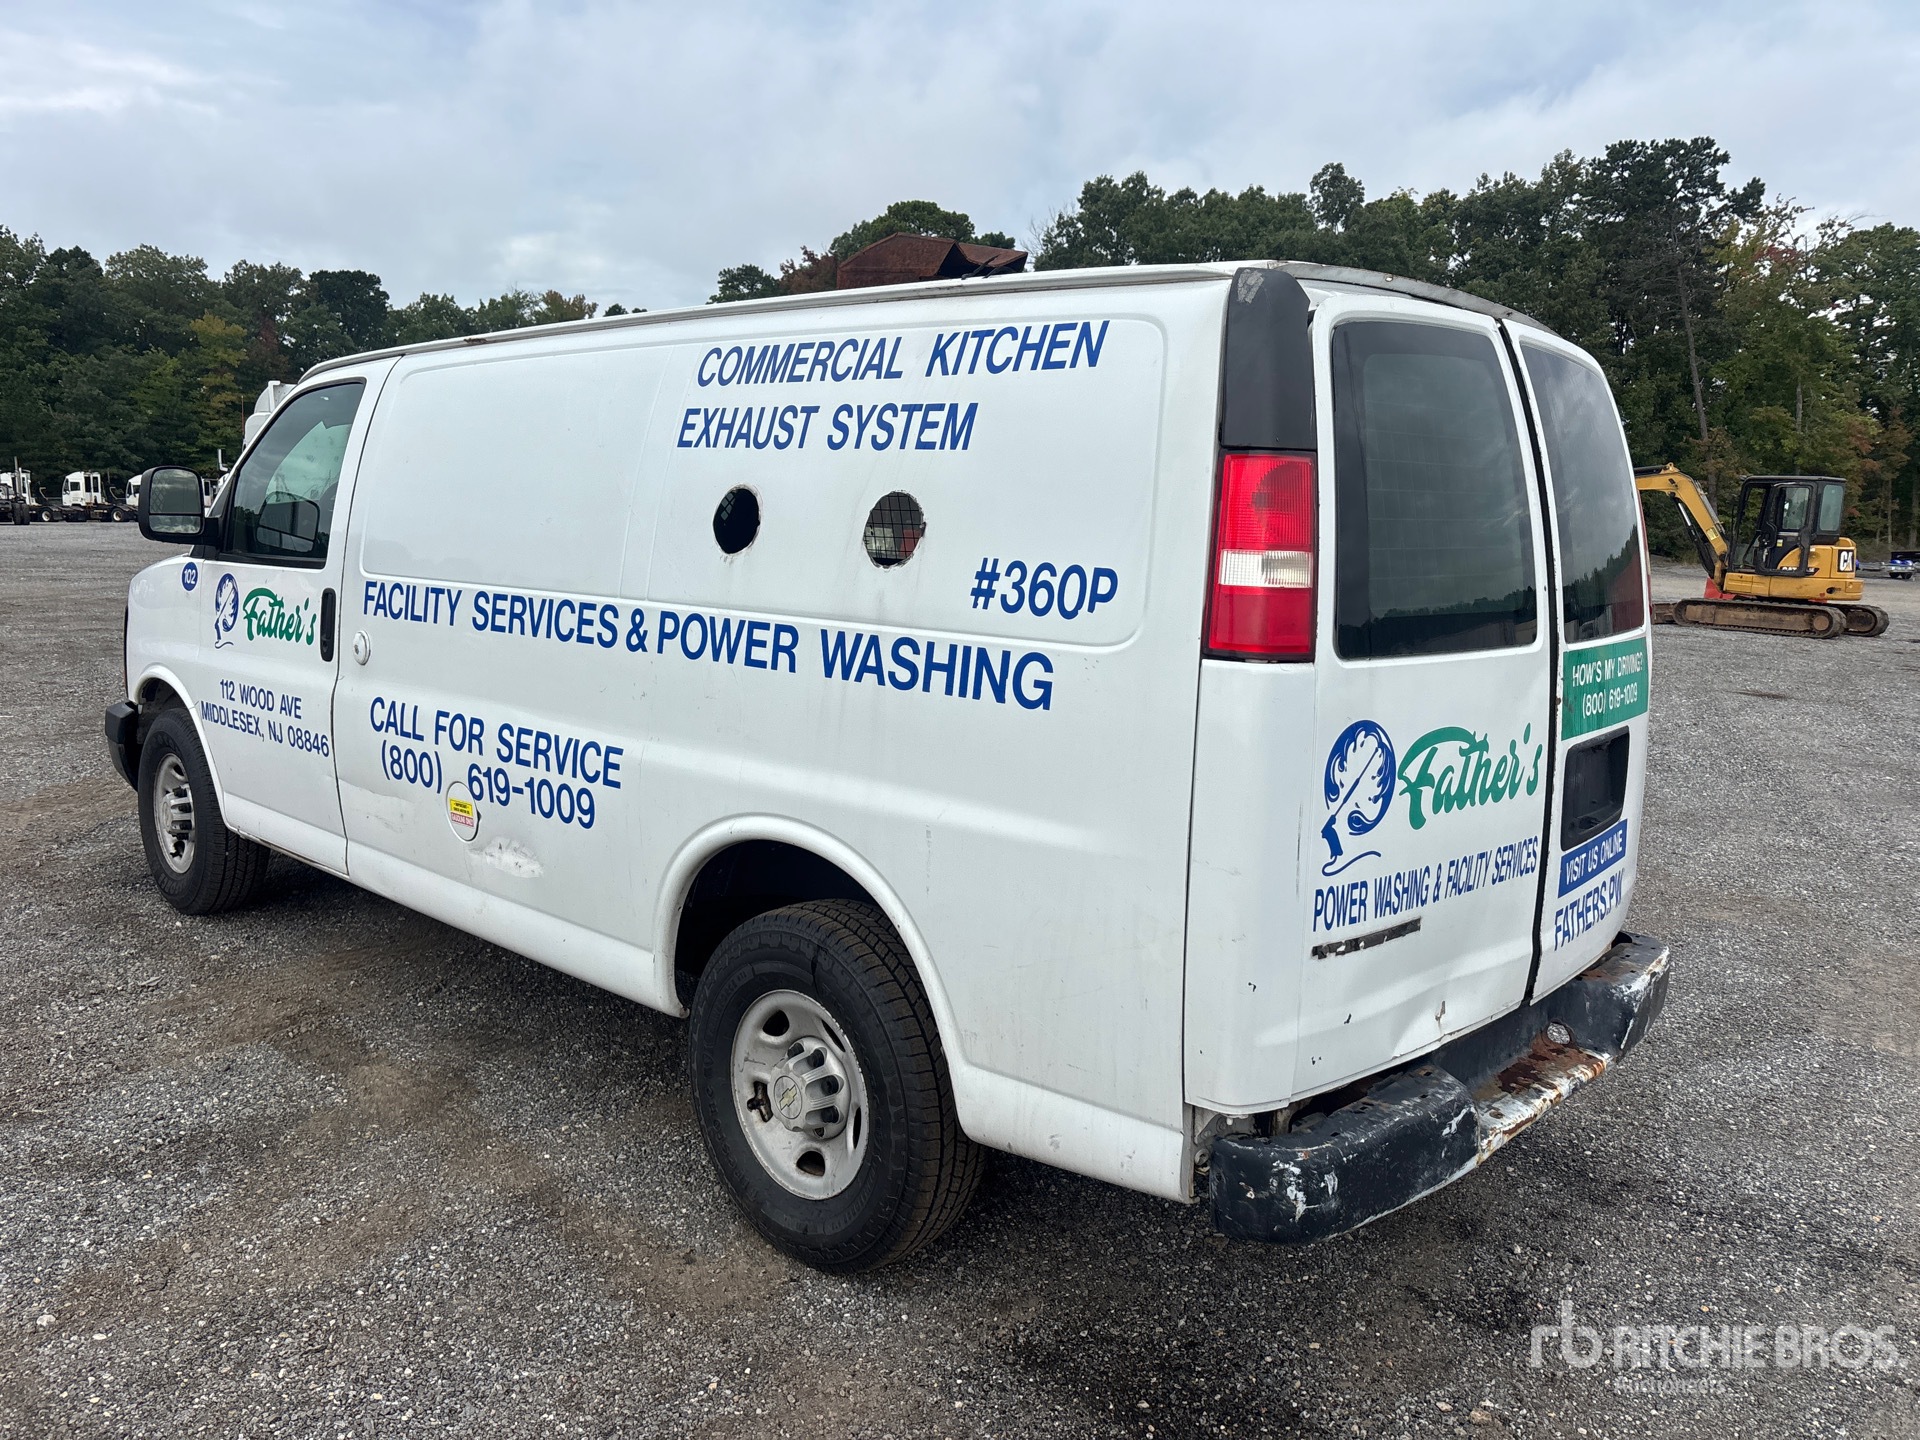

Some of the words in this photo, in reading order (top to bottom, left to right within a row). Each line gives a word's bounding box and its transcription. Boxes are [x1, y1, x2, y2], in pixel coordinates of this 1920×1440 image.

[697, 337, 903, 387] COMMERCIAL
[925, 320, 1110, 377] KITCHEN
[677, 405, 820, 450] EXHAUST
[827, 402, 978, 451] SYSTEM
[183, 569, 196, 585] 102
[970, 557, 1118, 620] #360P
[243, 588, 317, 645] Father's
[363, 581, 463, 626] FACILITY
[472, 590, 619, 648] SERVICES
[625, 608, 648, 653] &
[656, 610, 800, 673] POWER
[820, 628, 1054, 711] WASHING
[220, 679, 235, 701] 112
[239, 683, 274, 711] WOOD
[280, 694, 302, 719] AVE
[1572, 660, 1602, 687] HOW'S
[1604, 658, 1615, 680] MY
[1617, 652, 1642, 677] DRIVING?
[201, 701, 264, 742] MIDDLESEX,
[268, 720, 283, 743] NJ
[287, 726, 329, 757] 08846
[1582, 689, 1606, 719] (800)
[1608, 682, 1638, 710] 619-1009
[370, 697, 425, 742] CALL
[434, 709, 484, 756] FOR
[496, 723, 624, 789] SERVICE
[381, 740, 442, 794] (800)
[467, 763, 596, 829] 619-1009
[1397, 722, 1543, 830] Father's
[1313, 880, 1368, 932] POWER
[1374, 865, 1430, 919] WASHING
[1432, 863, 1442, 903] &
[1444, 850, 1492, 899] FACILITY
[1491, 835, 1538, 886] SERVICES
[1566, 852, 1587, 885] VISIT
[1587, 845, 1599, 873] US
[1600, 829, 1623, 865] ONLINE
[1554, 867, 1625, 951] FATHERS.PW
